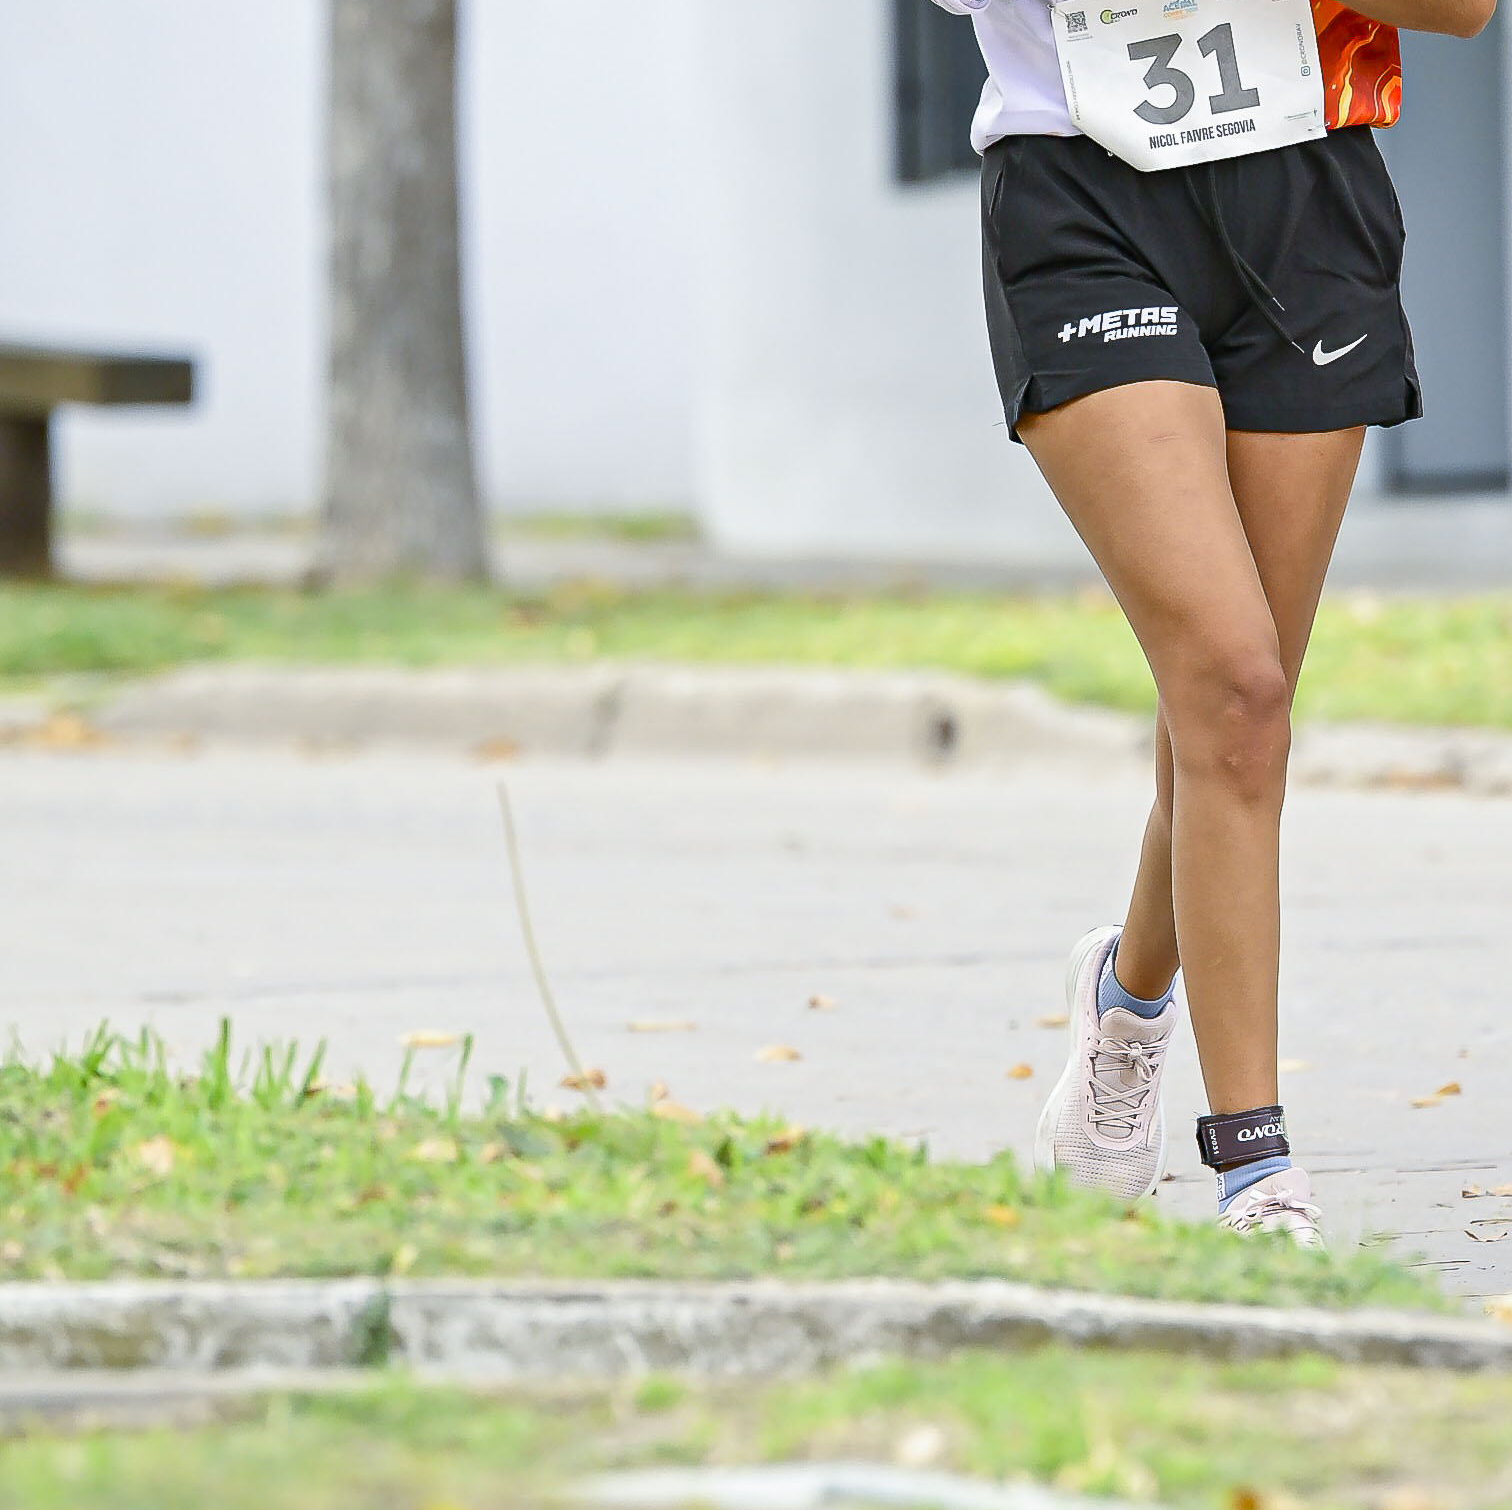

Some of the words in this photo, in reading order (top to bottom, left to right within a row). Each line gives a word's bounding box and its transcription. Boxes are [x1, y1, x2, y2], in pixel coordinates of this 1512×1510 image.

[1127, 22, 1260, 125] 31
[1149, 133, 1179, 149] NICOL
[1180, 126, 1215, 144] FAIVRE
[1216, 119, 1256, 137] SEGOVIA
[1103, 324, 1178, 342] RUNNING
